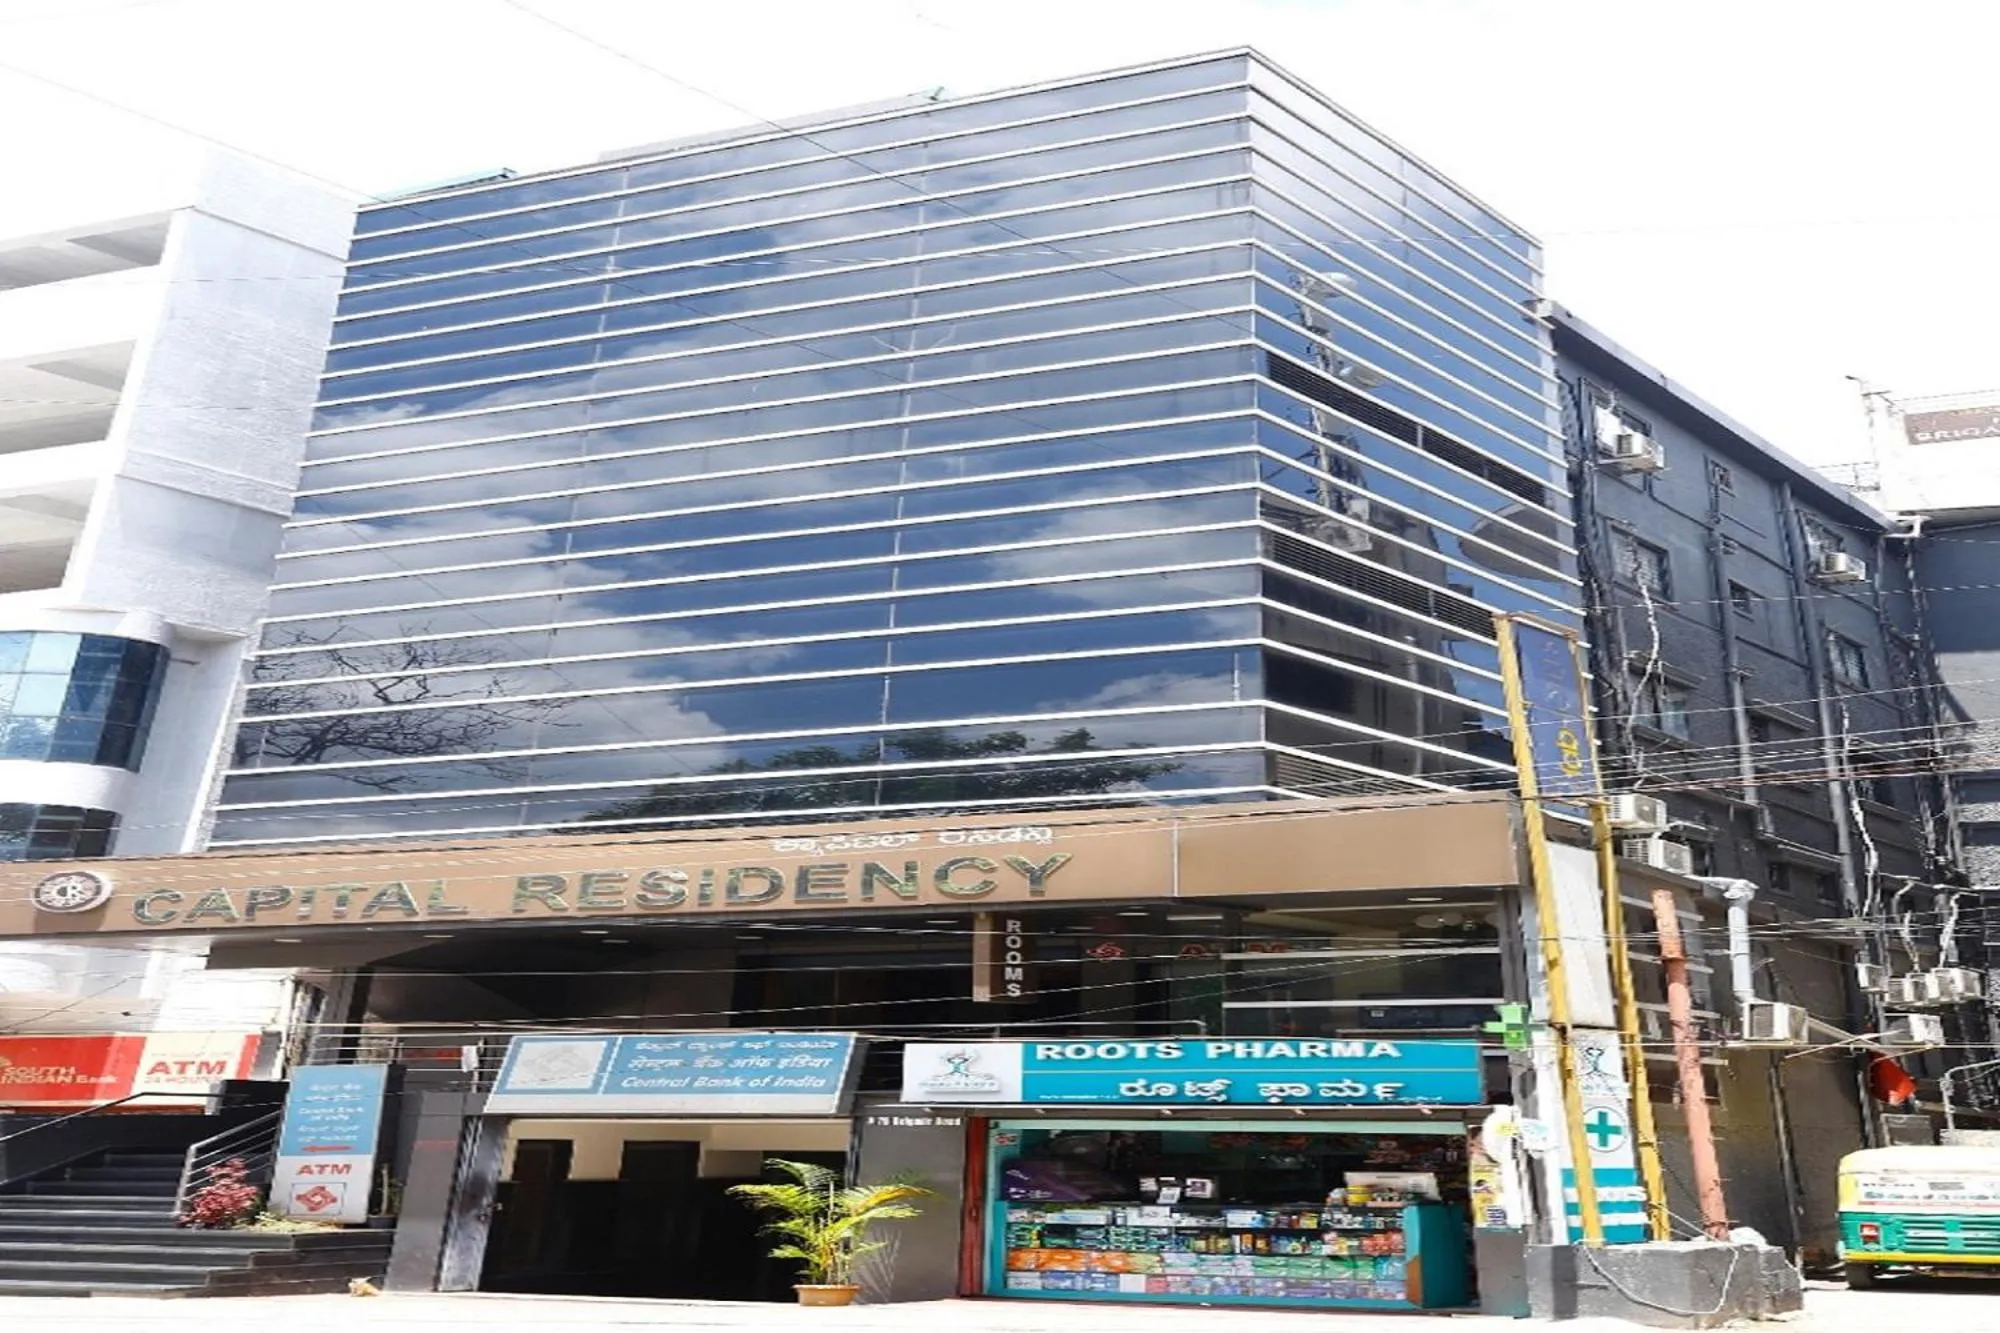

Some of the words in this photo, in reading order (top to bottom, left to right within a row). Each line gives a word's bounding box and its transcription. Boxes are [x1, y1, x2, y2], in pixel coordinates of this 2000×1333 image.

[131, 879, 469, 925] CAPITAL
[511, 853, 1073, 913] RESIDENCY
[1004, 919, 1023, 998] ROOMS
[1036, 1042, 1184, 1060] ROOTS
[1206, 1041, 1402, 1059] PHARMA
[4, 1066, 76, 1075] SOUTH
[146, 1060, 228, 1075] ATM
[620, 1076, 690, 1088] Central
[692, 1076, 742, 1088] Bank
[748, 1075, 772, 1088] of
[774, 1076, 827, 1088] India
[296, 1163, 352, 1176] ATM
